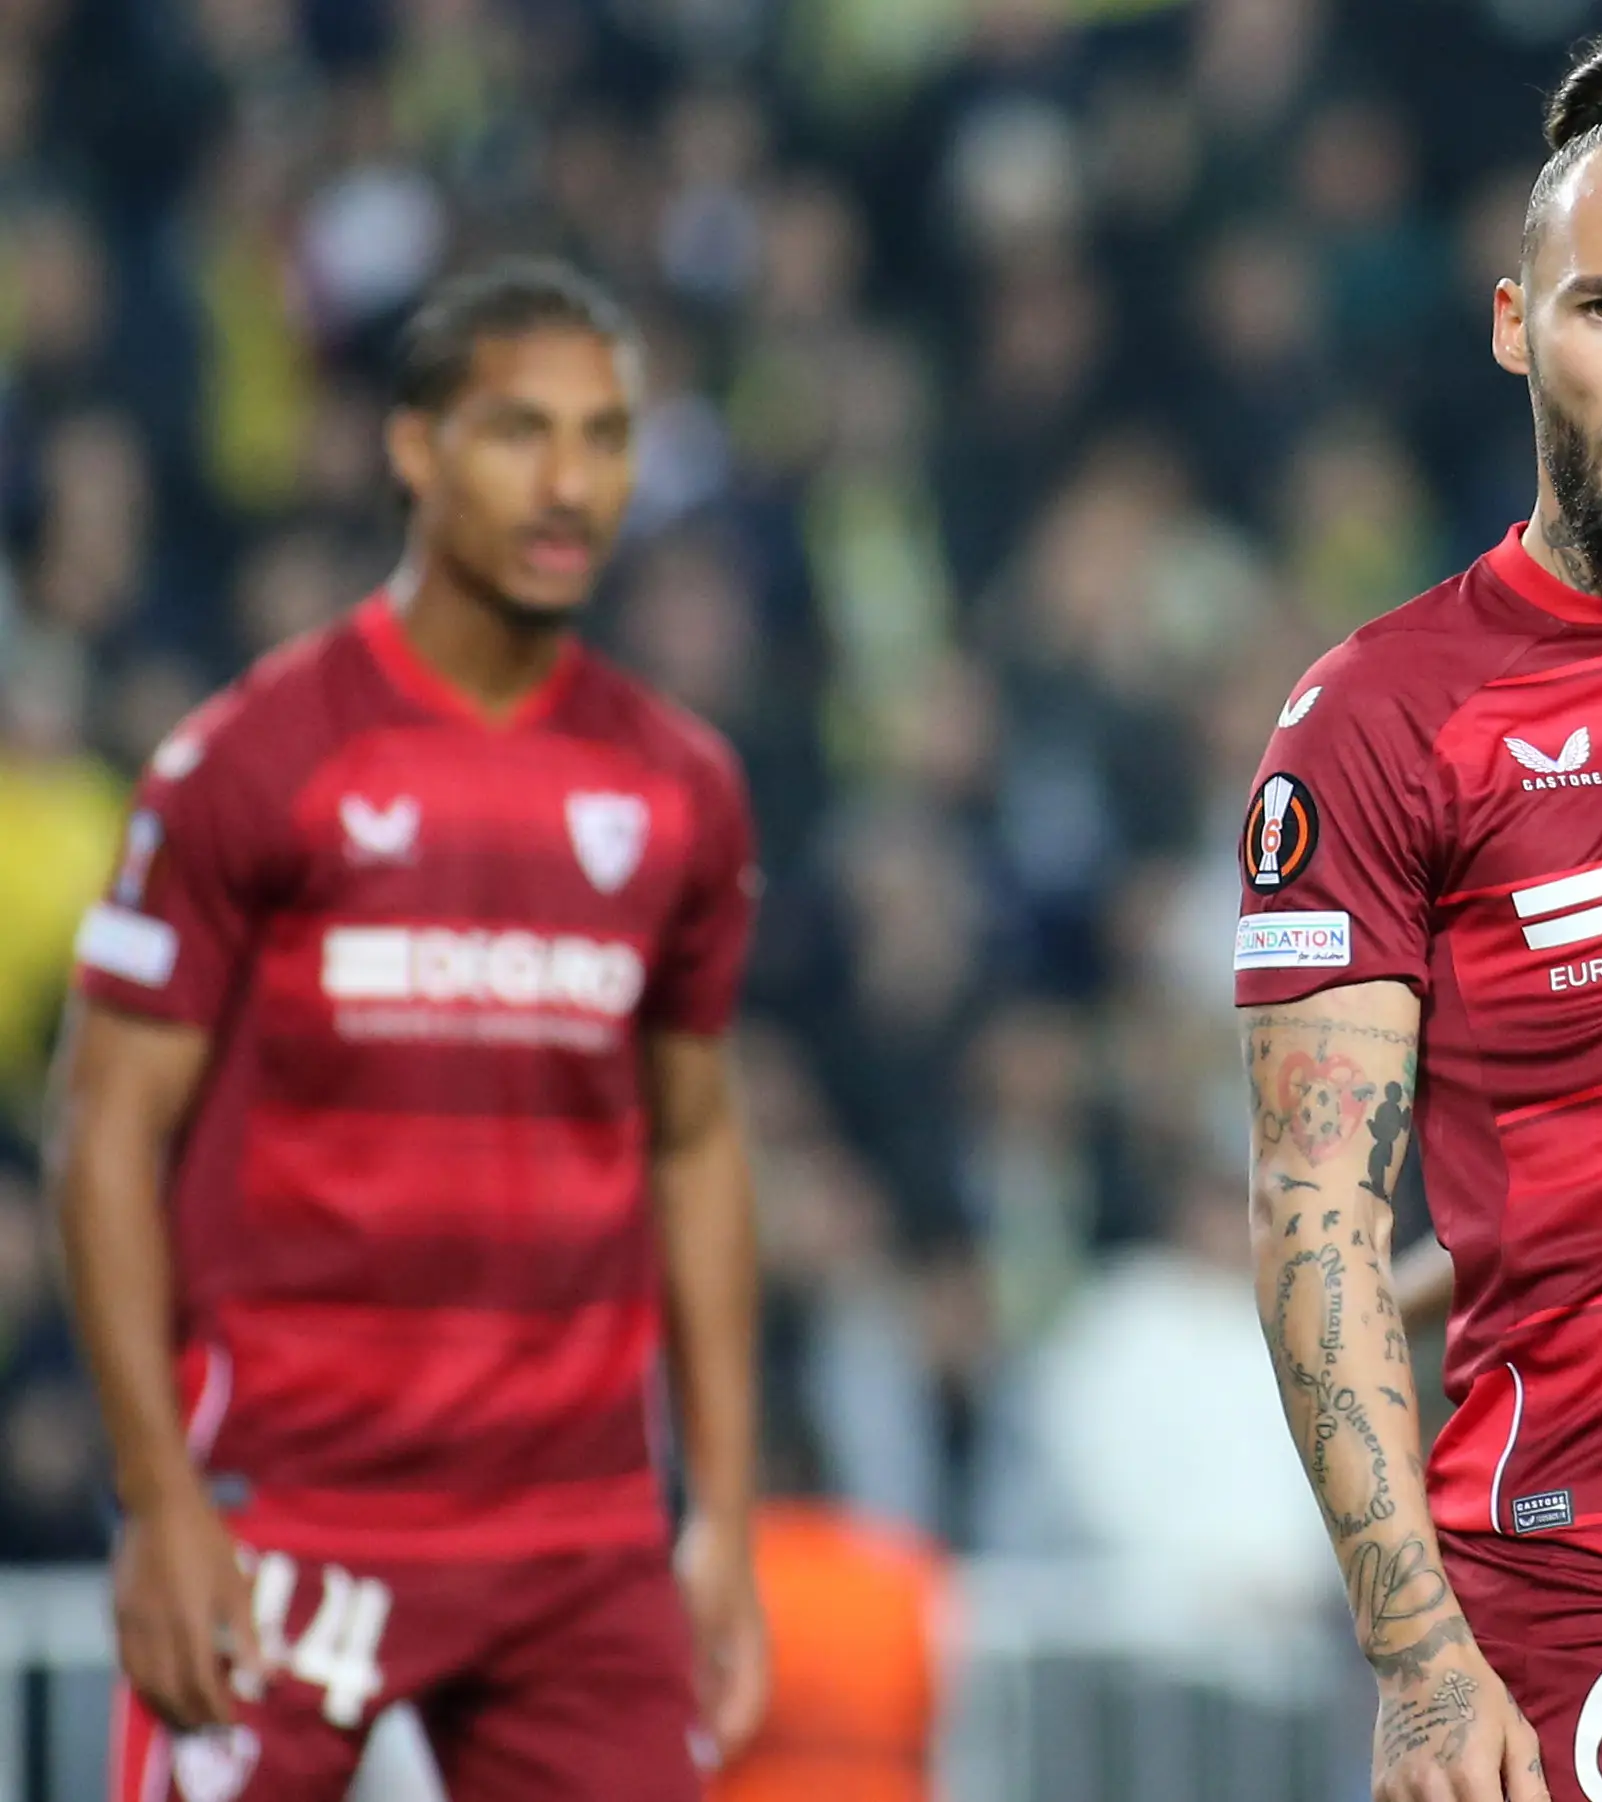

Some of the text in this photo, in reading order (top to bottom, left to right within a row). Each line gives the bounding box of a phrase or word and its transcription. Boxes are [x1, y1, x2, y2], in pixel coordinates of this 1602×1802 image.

[1522, 772, 1602, 791] CASTORE
[1262, 816, 1281, 853] 6
[1237, 929, 1345, 950] UNDATION
[1517, 1496, 1564, 1511] CASTORE
